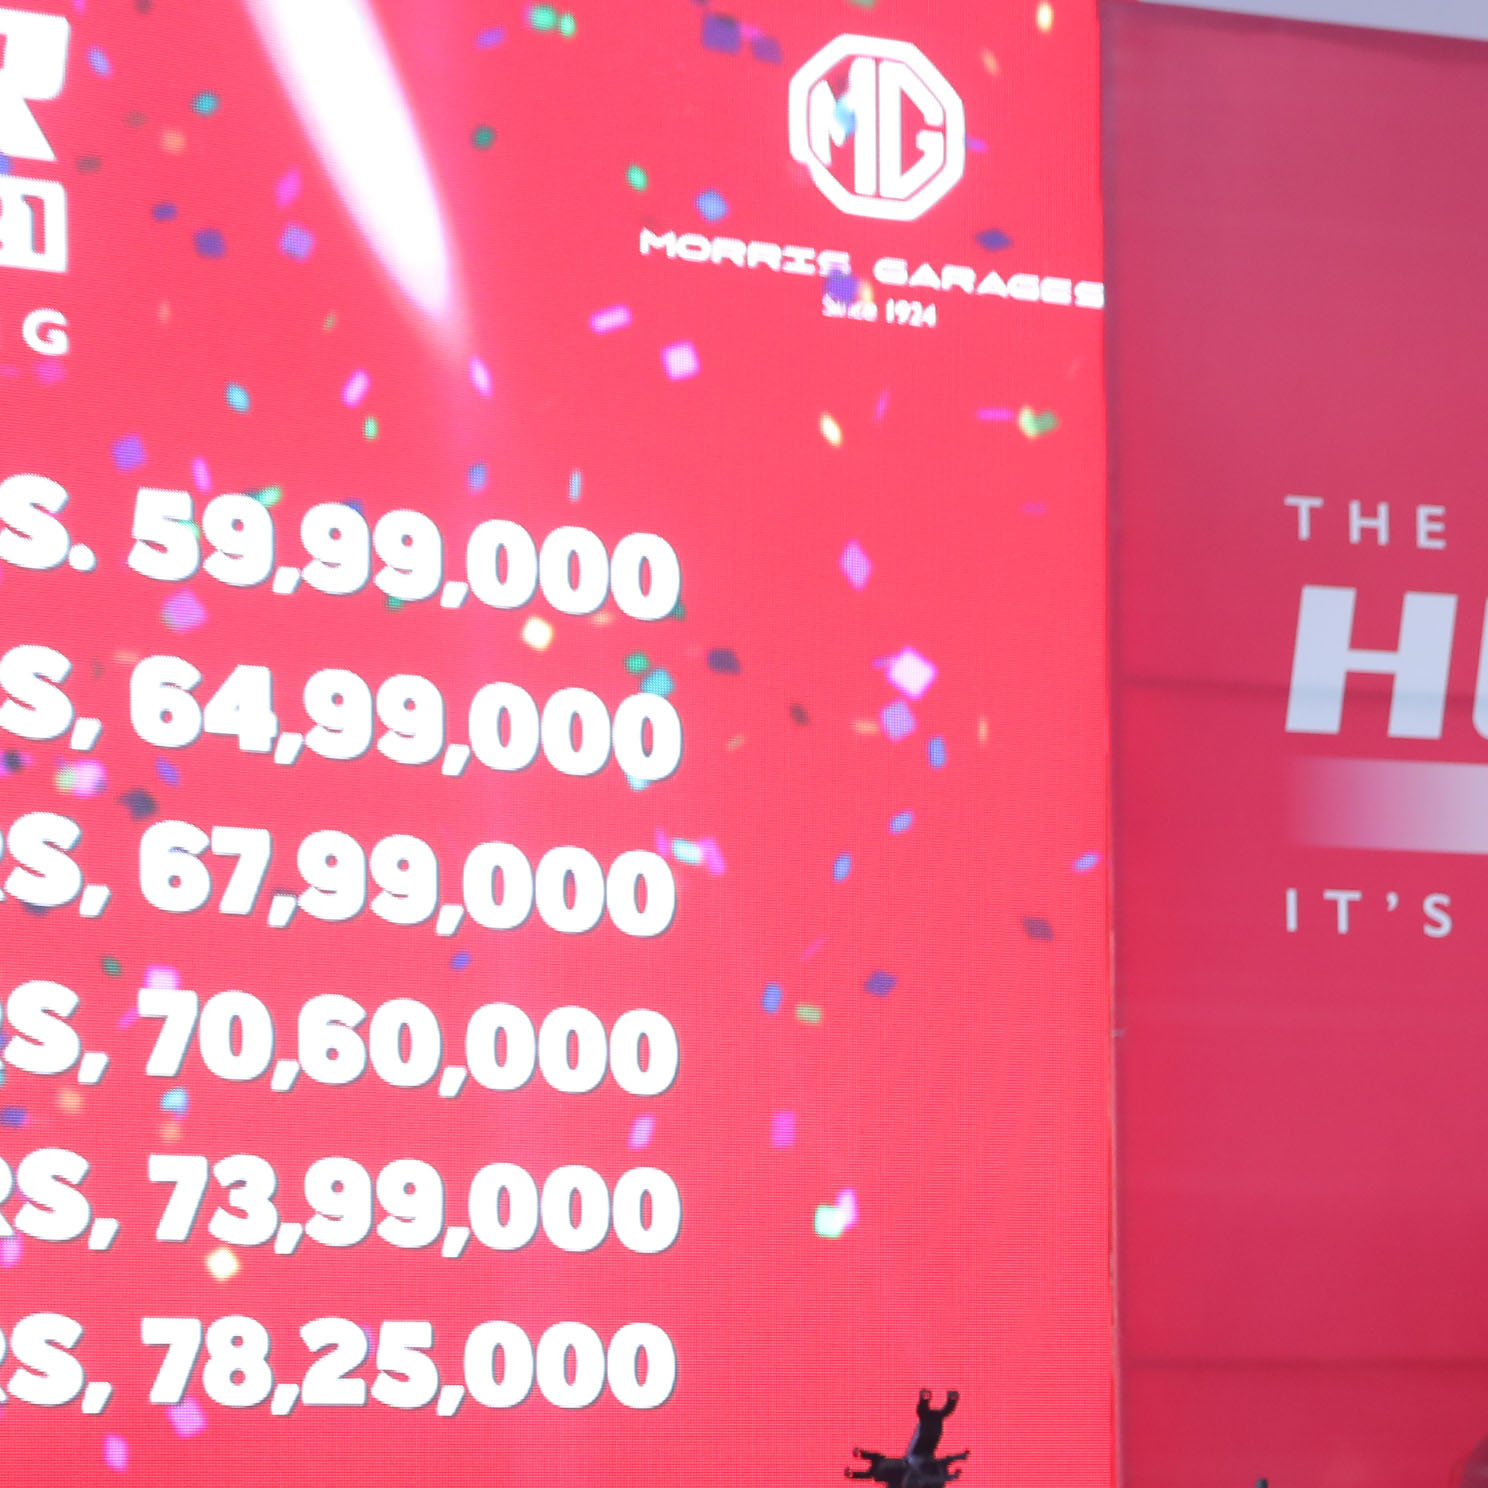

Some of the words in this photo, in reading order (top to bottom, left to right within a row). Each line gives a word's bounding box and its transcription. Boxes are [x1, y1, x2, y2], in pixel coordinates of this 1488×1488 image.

[806, 54, 947, 203] MG
[639, 227, 852, 278] MORRIS
[872, 256, 1105, 310] GARAGES
[885, 297, 938, 328] 1924
[127, 486, 681, 621] 59,99,000
[1284, 495, 1447, 550] THE
[129, 654, 682, 780] 64,99,000
[0, 811, 112, 918] S,
[139, 819, 678, 937] 67,99,000
[0, 979, 110, 1086] S,
[137, 987, 679, 1096] 70,60,000
[0, 1147, 121, 1253] S,
[147, 1153, 681, 1254] 73,99,000
[0, 1312, 113, 1415] S,
[140, 1315, 677, 1417] 78,25,000
